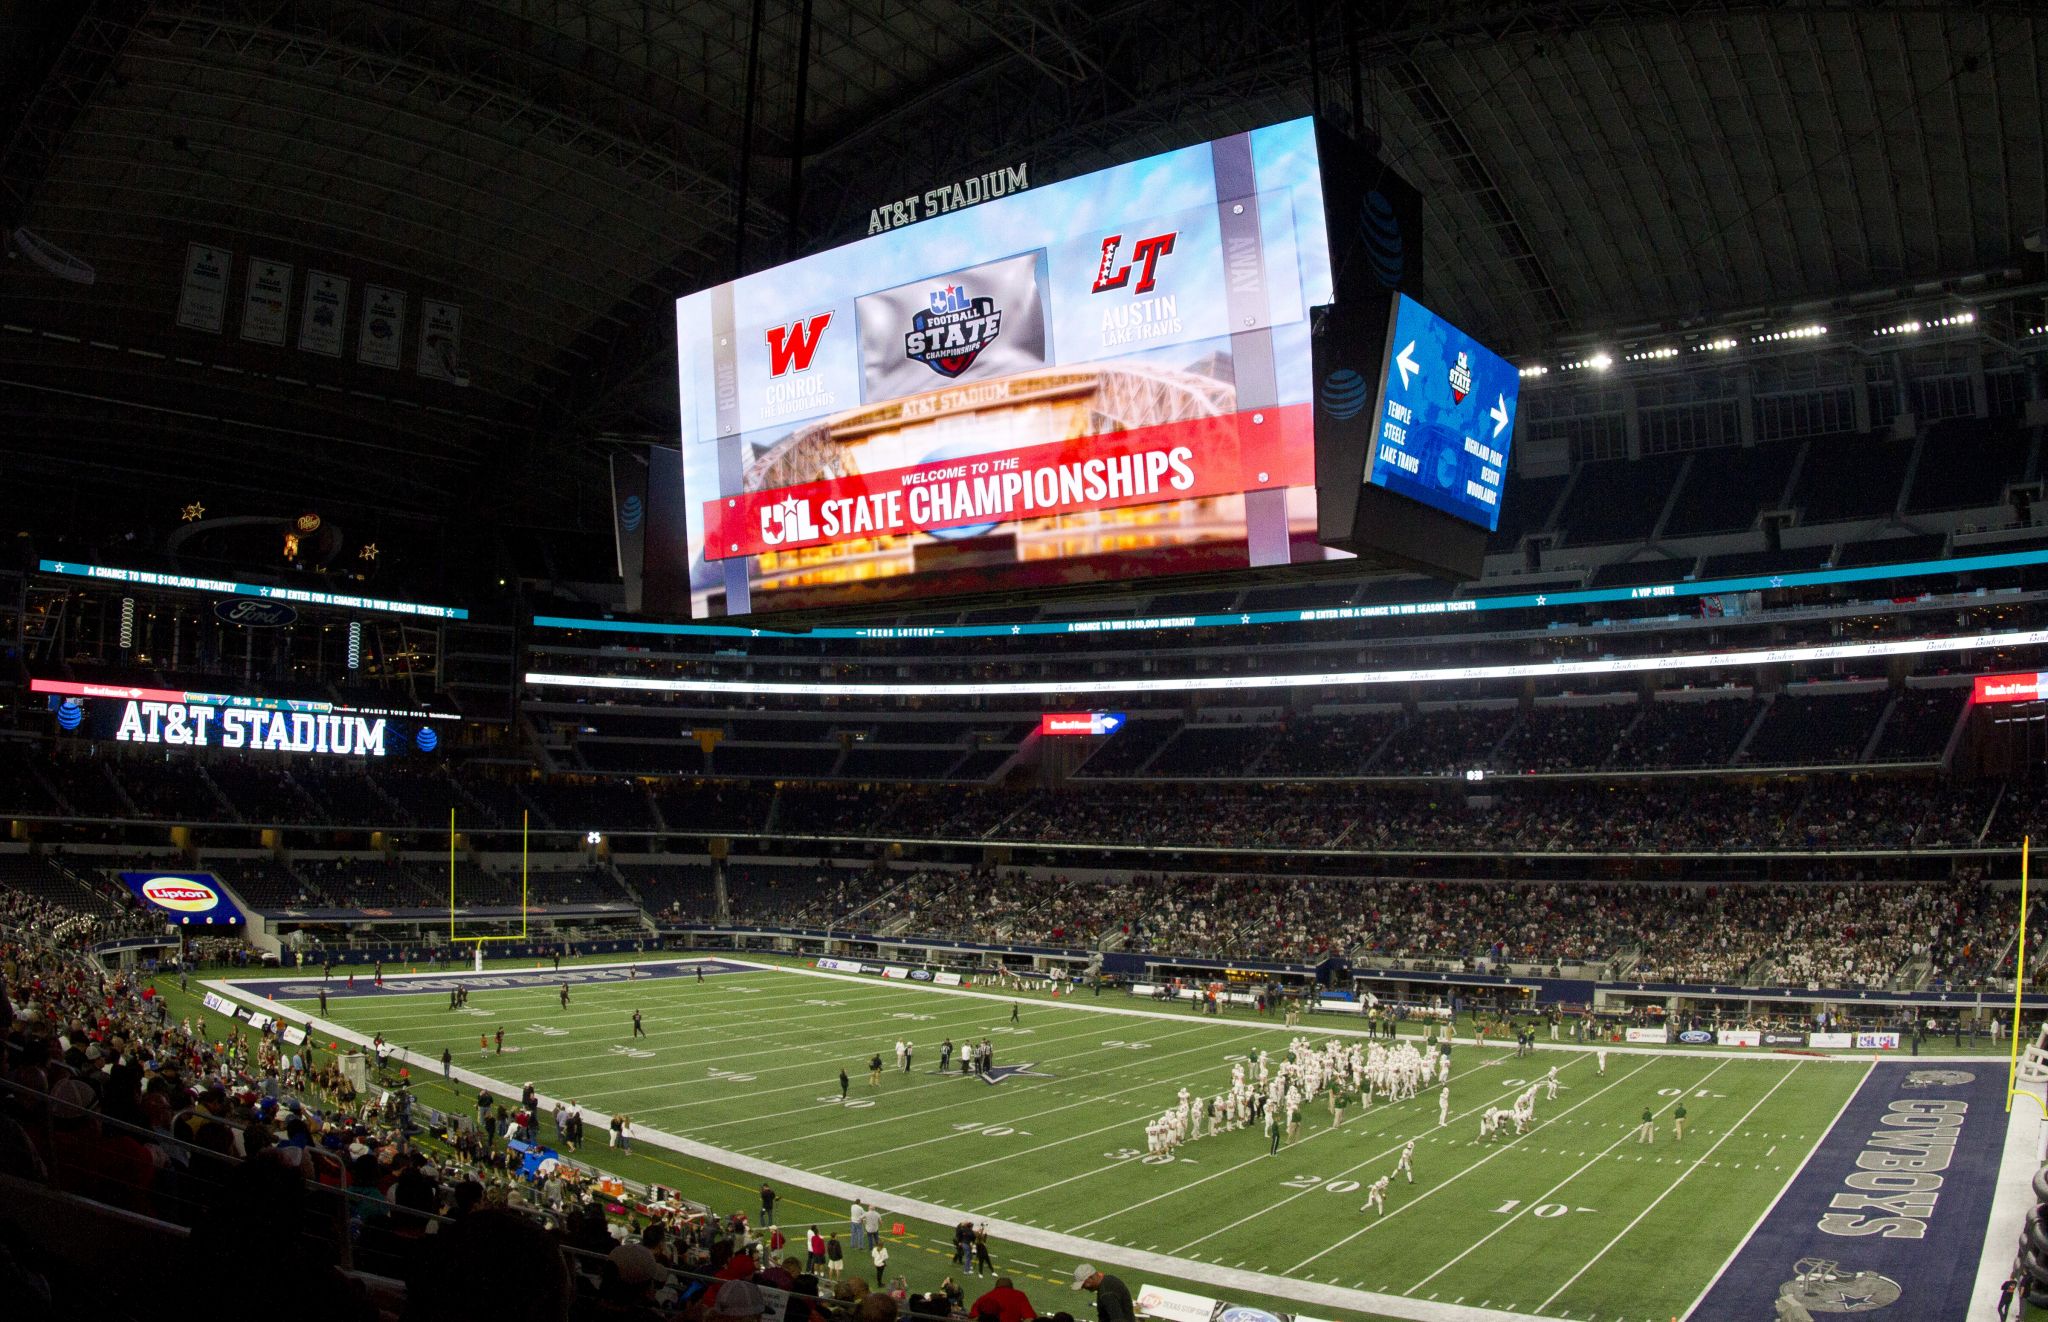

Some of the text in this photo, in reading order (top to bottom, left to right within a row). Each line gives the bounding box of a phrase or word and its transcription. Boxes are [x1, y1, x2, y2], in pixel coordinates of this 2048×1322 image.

[868, 163, 1029, 235] AT&T STADIUM
[1091, 231, 1178, 295] LT
[1229, 237, 1261, 293] AWAY
[927, 308, 980, 328] FOOTBALL
[1102, 295, 1177, 332] AUSTIN
[765, 310, 835, 379] W
[907, 313, 1000, 354] STATE
[1103, 318, 1182, 347] LAKE TRAVIS
[926, 341, 981, 360] CHAMPIONSHIPS
[718, 362, 735, 411] HOME
[766, 374, 825, 406] CONROE
[1449, 368, 1472, 392] STATE
[760, 391, 835, 419] THE WOODLANDS
[901, 382, 1011, 418] AT&T STADIUM
[1387, 400, 1412, 426] TEMPLE
[1383, 422, 1406, 446] STEELE
[1379, 444, 1420, 475] LAKE TRAVIS
[1464, 436, 1504, 468] HIGHLAND PARK
[901, 457, 1020, 487] WELCOME TO THE
[1480, 466, 1500, 487] DESOTO
[820, 492, 904, 537] STATE
[908, 446, 1196, 526] CHAMPIONSHIPS
[1466, 480, 1497, 506] WOODLANDS
[88, 566, 237, 593] A CHANCE TO WIN $100,000 INSTANTLY
[1632, 586, 1675, 598] A VIP SUITE
[229, 601, 284, 623] Ford
[270, 588, 444, 617] AND ENTER FOR A CHANCE TO WIN SEASON TICKETS
[1300, 600, 1476, 620] AND ENTER FOR A CHANCE TO WIN SEASON TICKETS
[867, 627, 935, 637] TEXAS LOTTERY
[1068, 617, 1196, 631] A CHANCE TO WIN $100,000 INSTANTLY
[83, 687, 99, 695] Bank
[104, 688, 128, 697] America
[1985, 685, 2006, 696] Bank
[2006, 683, 2015, 695] of
[116, 700, 386, 755] AT&T STADIUM
[152, 889, 207, 899] Lipton
[952, 1122, 1015, 1136] 40
[1103, 1148, 1175, 1165] 30
[1817, 1099, 1968, 1239] COWBOYS
[1280, 1175, 1360, 1192] 20
[1488, 1200, 1568, 1218] 10
[1163, 1301, 1180, 1311] TEXAS
[1181, 1304, 1195, 1314] STOP
